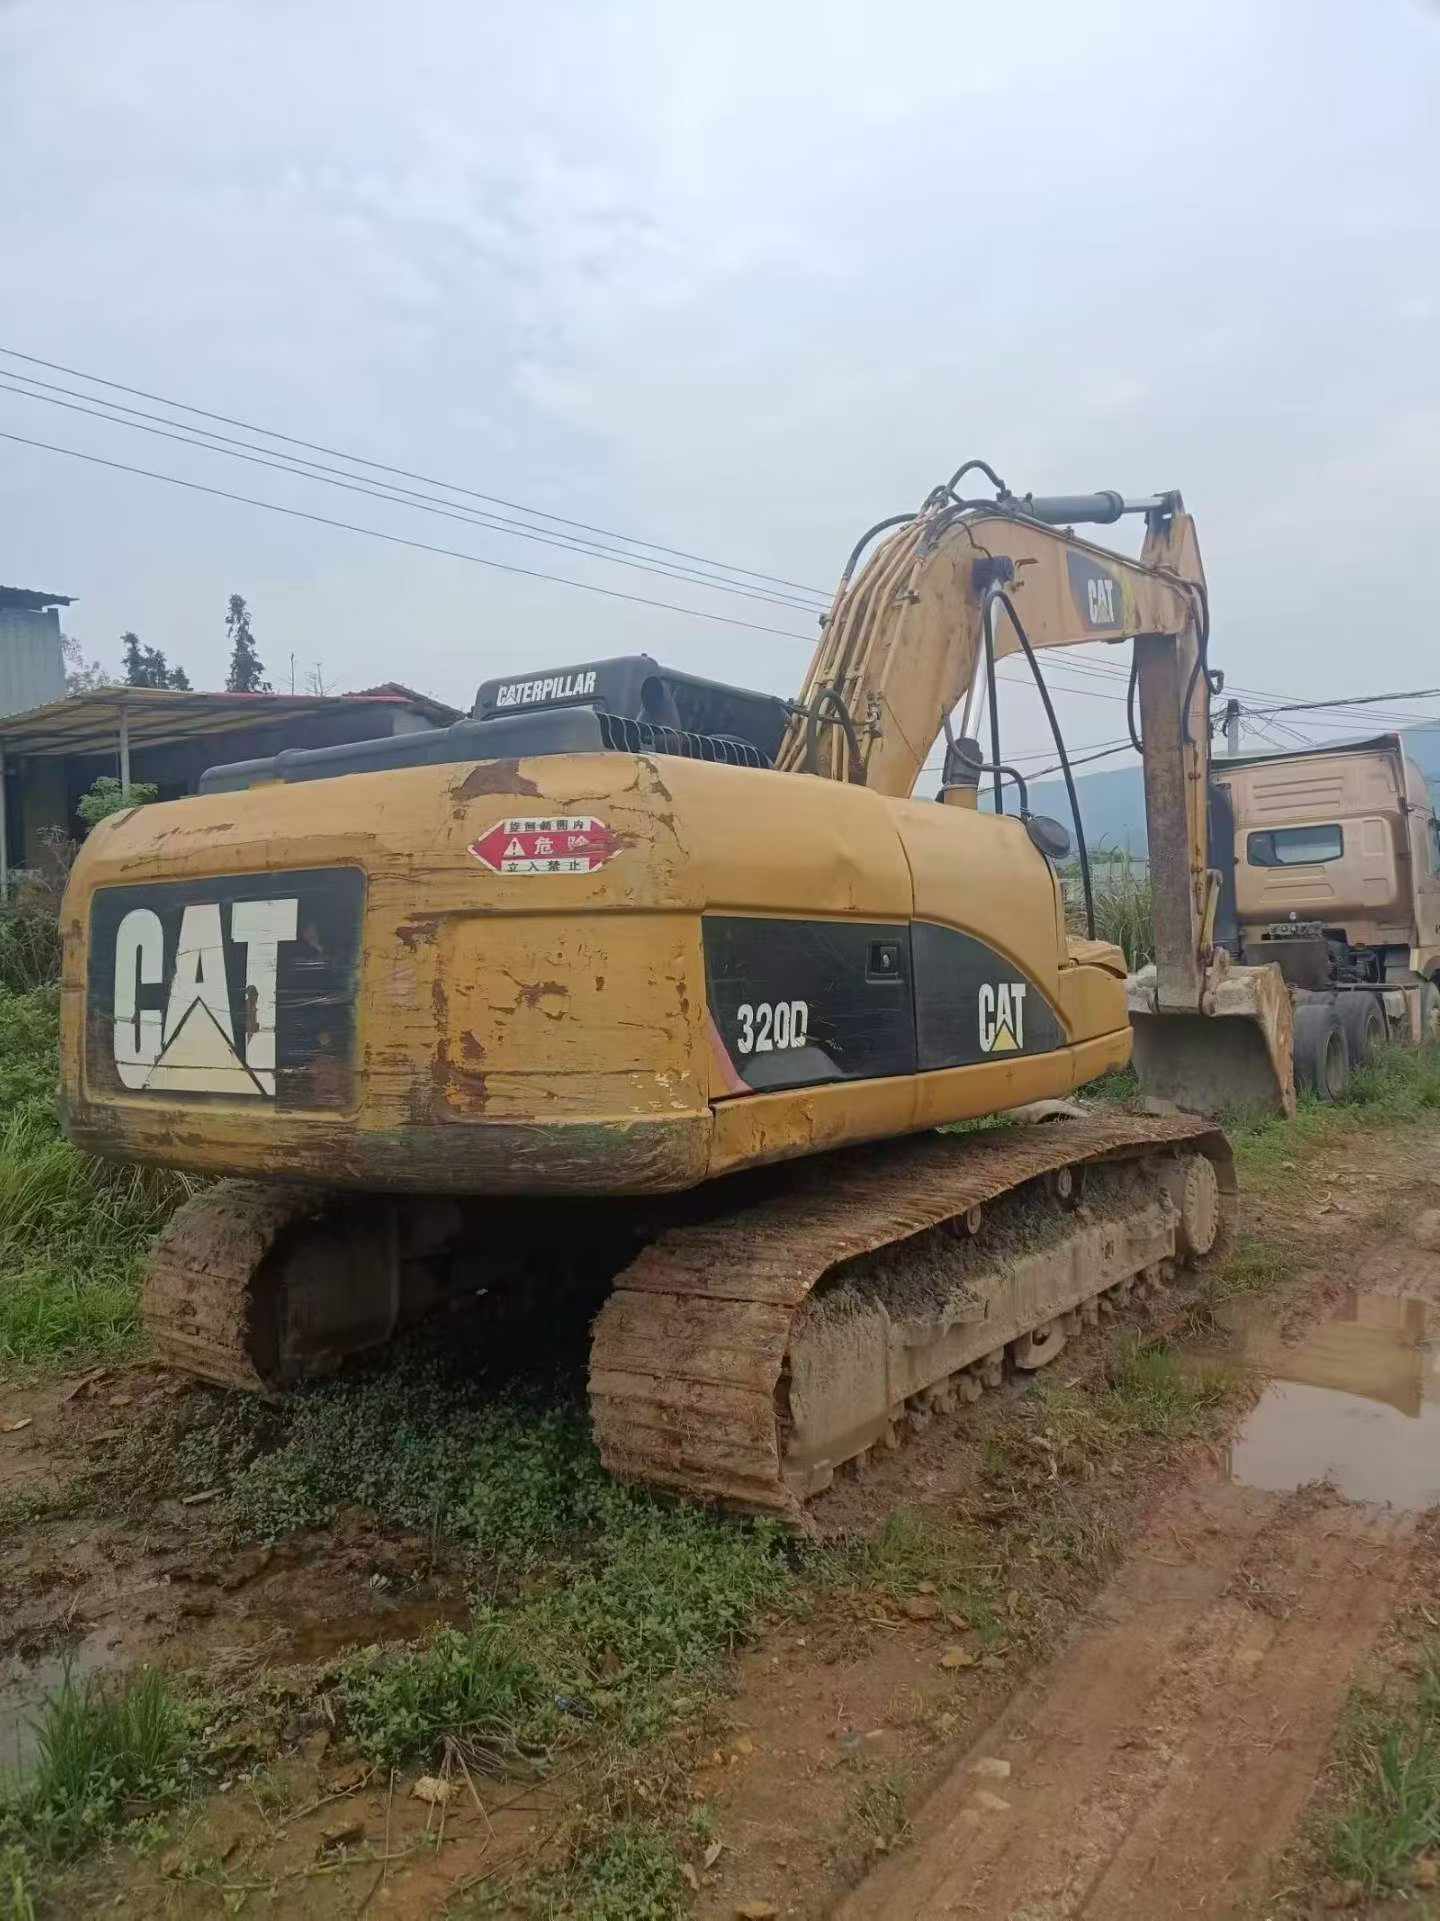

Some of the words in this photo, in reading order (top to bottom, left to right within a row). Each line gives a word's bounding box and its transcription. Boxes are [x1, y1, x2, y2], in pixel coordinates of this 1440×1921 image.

[1088, 579, 1114, 624] CAT
[496, 672, 597, 706] CATERPILLAR
[114, 898, 298, 1096] CAT
[979, 983, 1026, 1052] CAT
[737, 1001, 808, 1053] 320D
